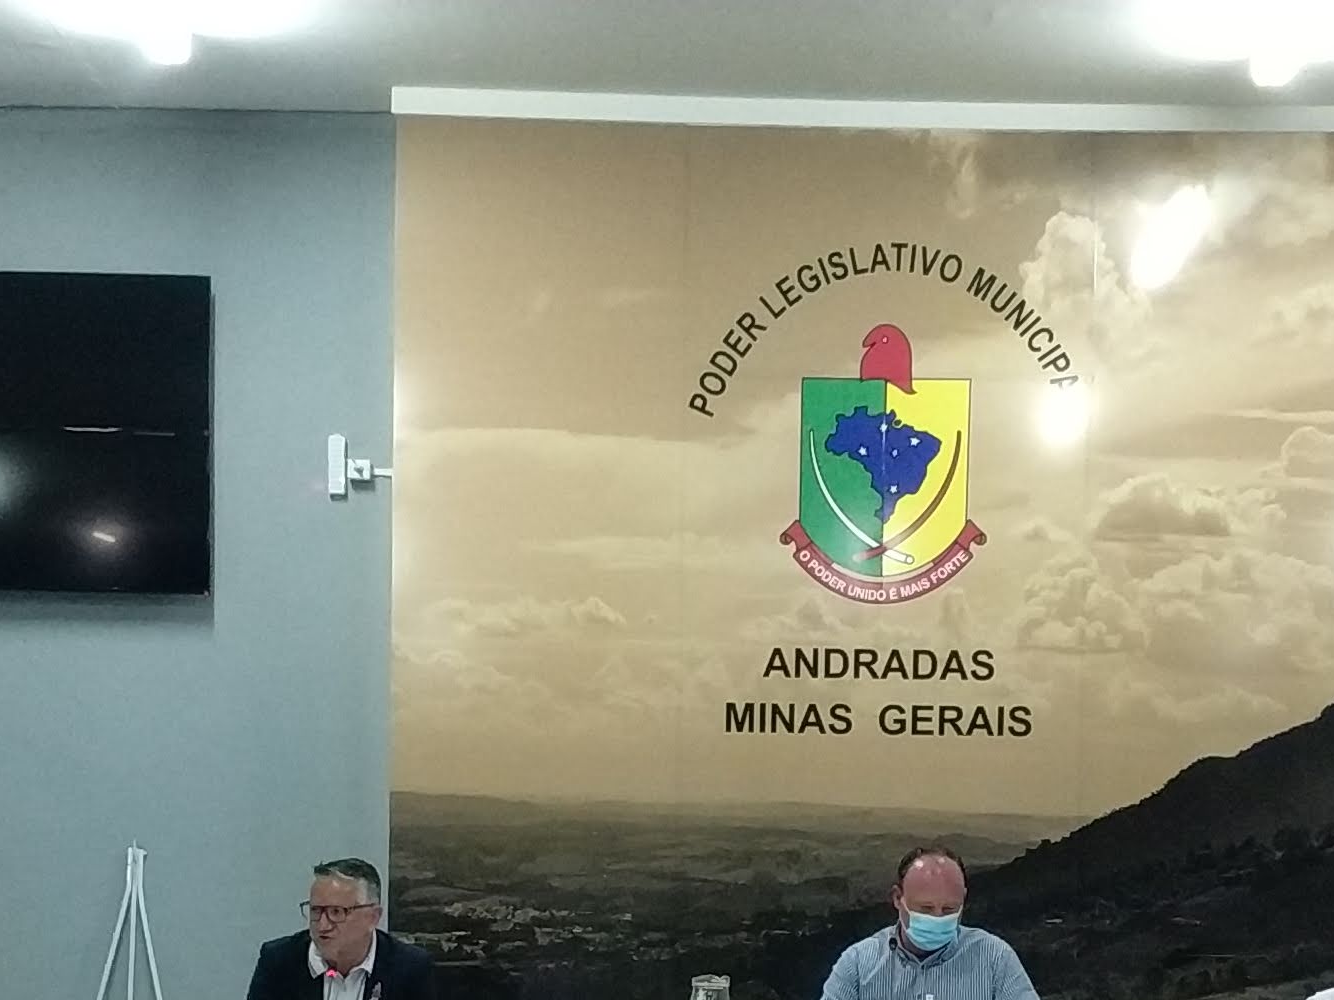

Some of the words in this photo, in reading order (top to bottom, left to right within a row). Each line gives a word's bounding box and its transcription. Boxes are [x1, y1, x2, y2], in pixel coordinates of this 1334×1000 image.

[688, 312, 767, 418] PODER
[759, 242, 963, 319] LEGISLATIVO
[966, 267, 1079, 391] MUNICIPA
[799, 550, 811, 562] O
[807, 560, 847, 592] PODER
[847, 584, 886, 601] UNIDO
[900, 579, 931, 598] MAIS
[931, 550, 969, 584] FORTE
[763, 647, 995, 681] ANDRADAS
[724, 702, 853, 734] MINAS
[878, 704, 1033, 737] GERAIS
